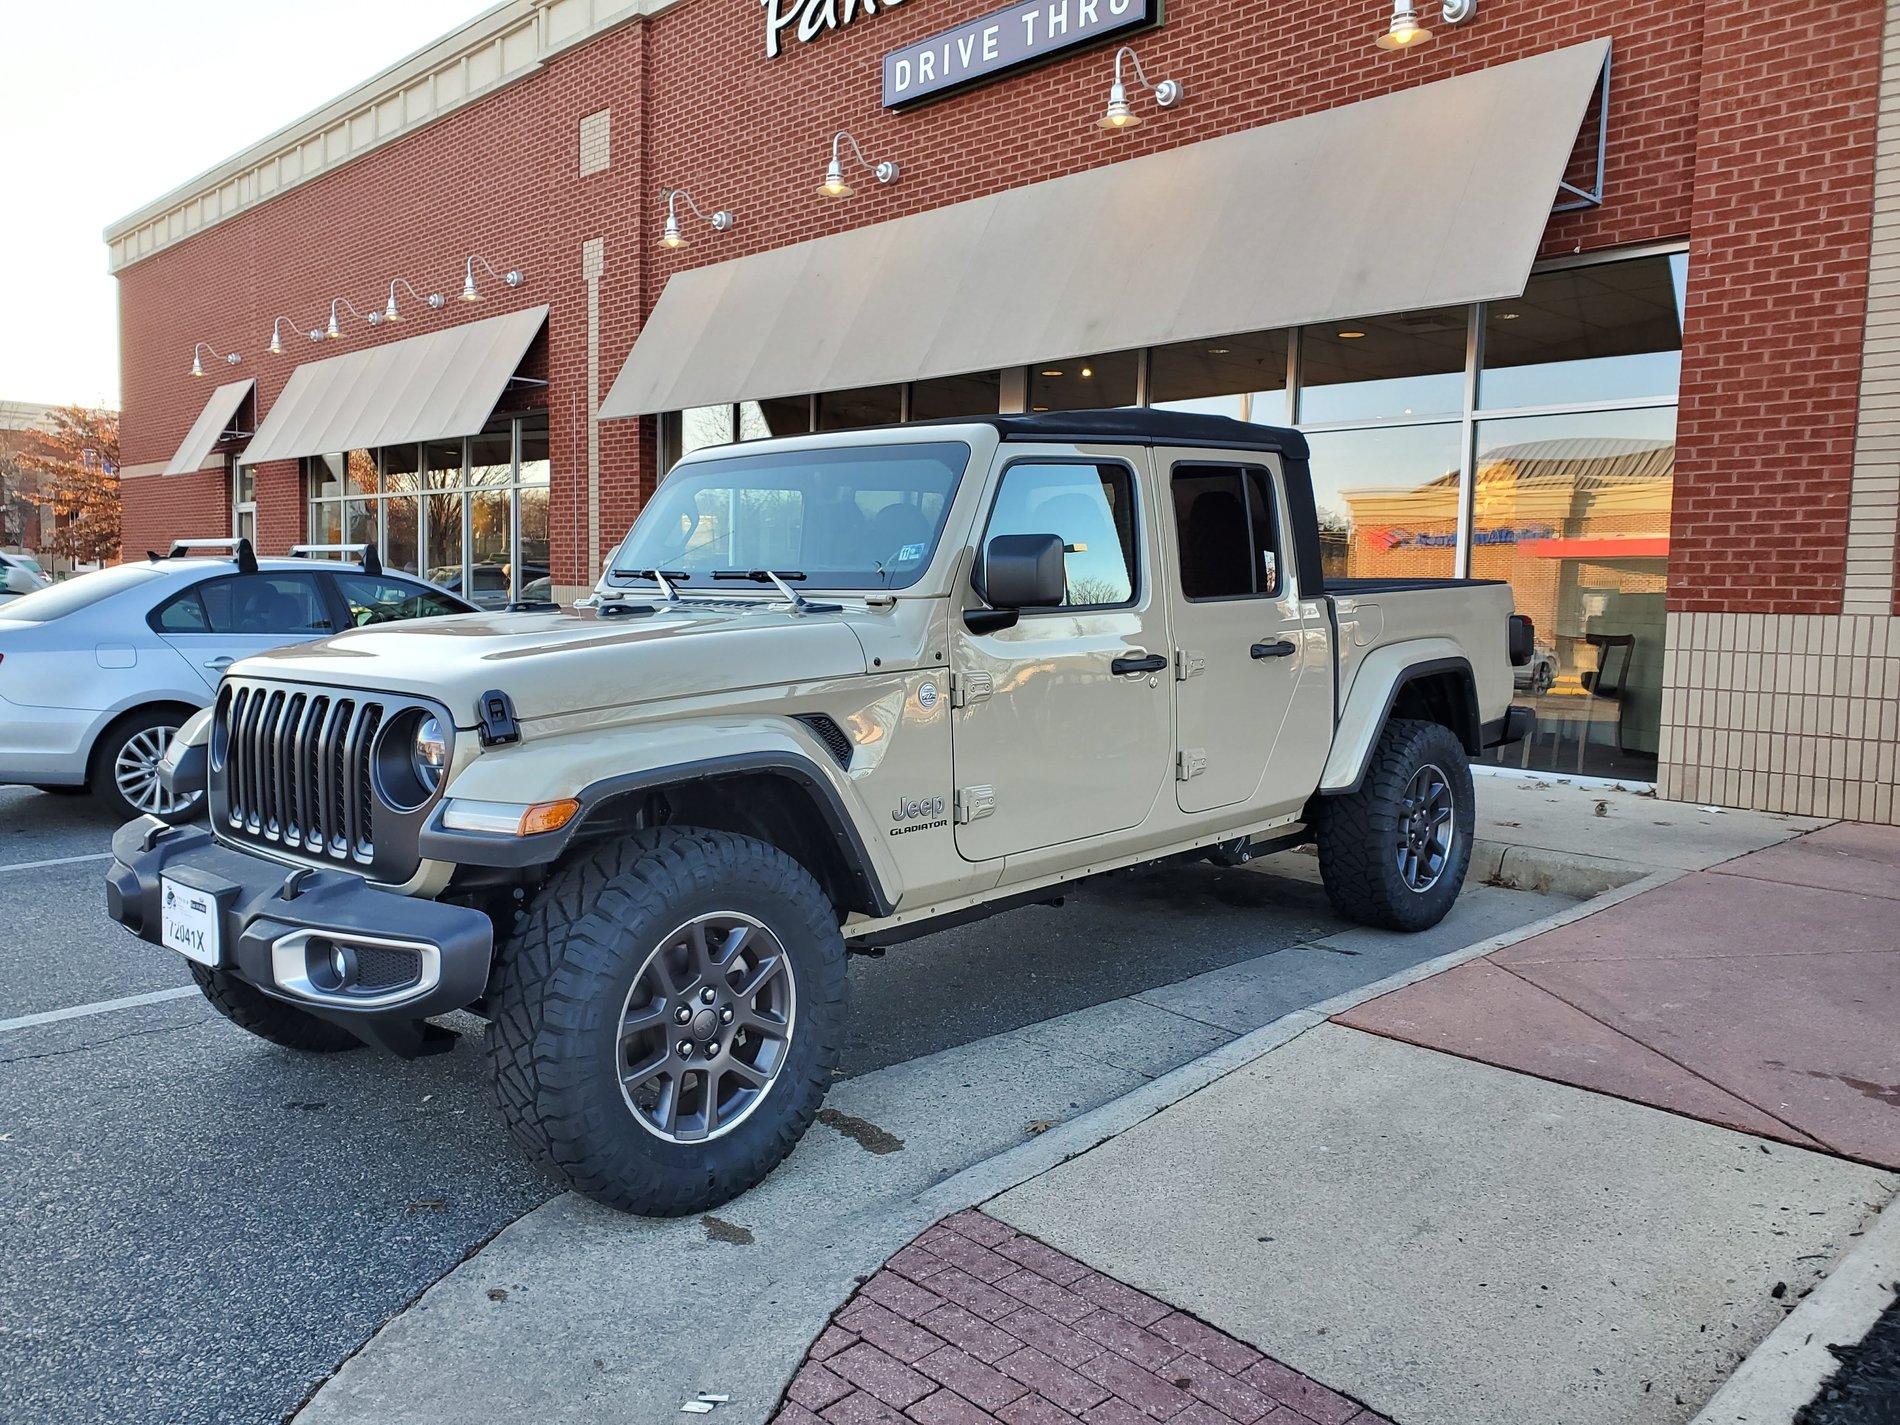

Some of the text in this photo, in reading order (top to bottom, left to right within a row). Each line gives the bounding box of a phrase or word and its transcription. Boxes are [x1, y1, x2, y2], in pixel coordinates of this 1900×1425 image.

[761, 0, 906, 58] Pa
[895, 25, 1000, 93] DRIVE
[890, 819, 948, 836] GLADIATOR
[892, 796, 945, 821] Jeep
